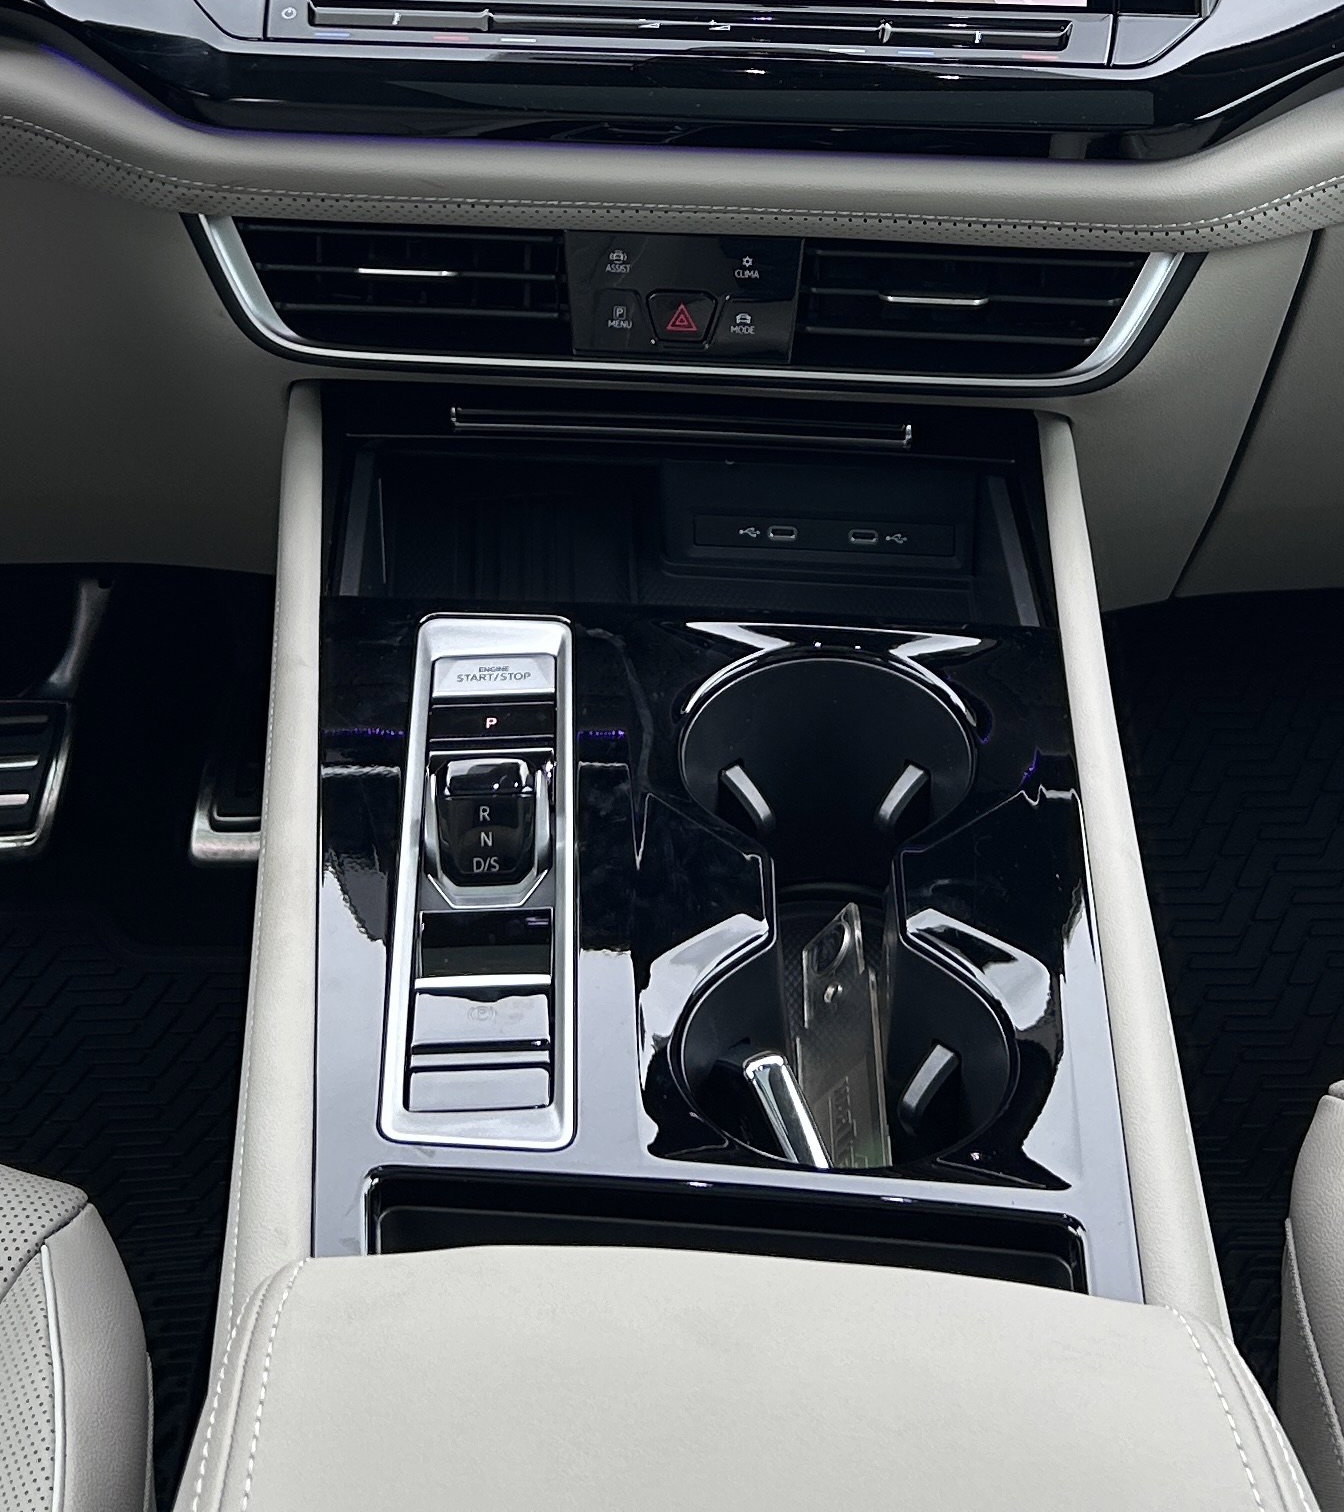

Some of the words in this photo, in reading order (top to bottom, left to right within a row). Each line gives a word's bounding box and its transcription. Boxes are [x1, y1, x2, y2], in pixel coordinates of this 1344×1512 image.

[606, 263, 631, 273] ASSIST
[734, 269, 760, 279] CLIMA
[607, 319, 632, 329] MENU
[730, 325, 756, 335] MODE
[478, 665, 510, 673] ENGINE
[456, 671, 532, 683] START/STOP
[485, 717, 498, 729] P
[479, 805, 491, 822] R
[480, 831, 493, 847] N
[472, 856, 500, 873] D/S
